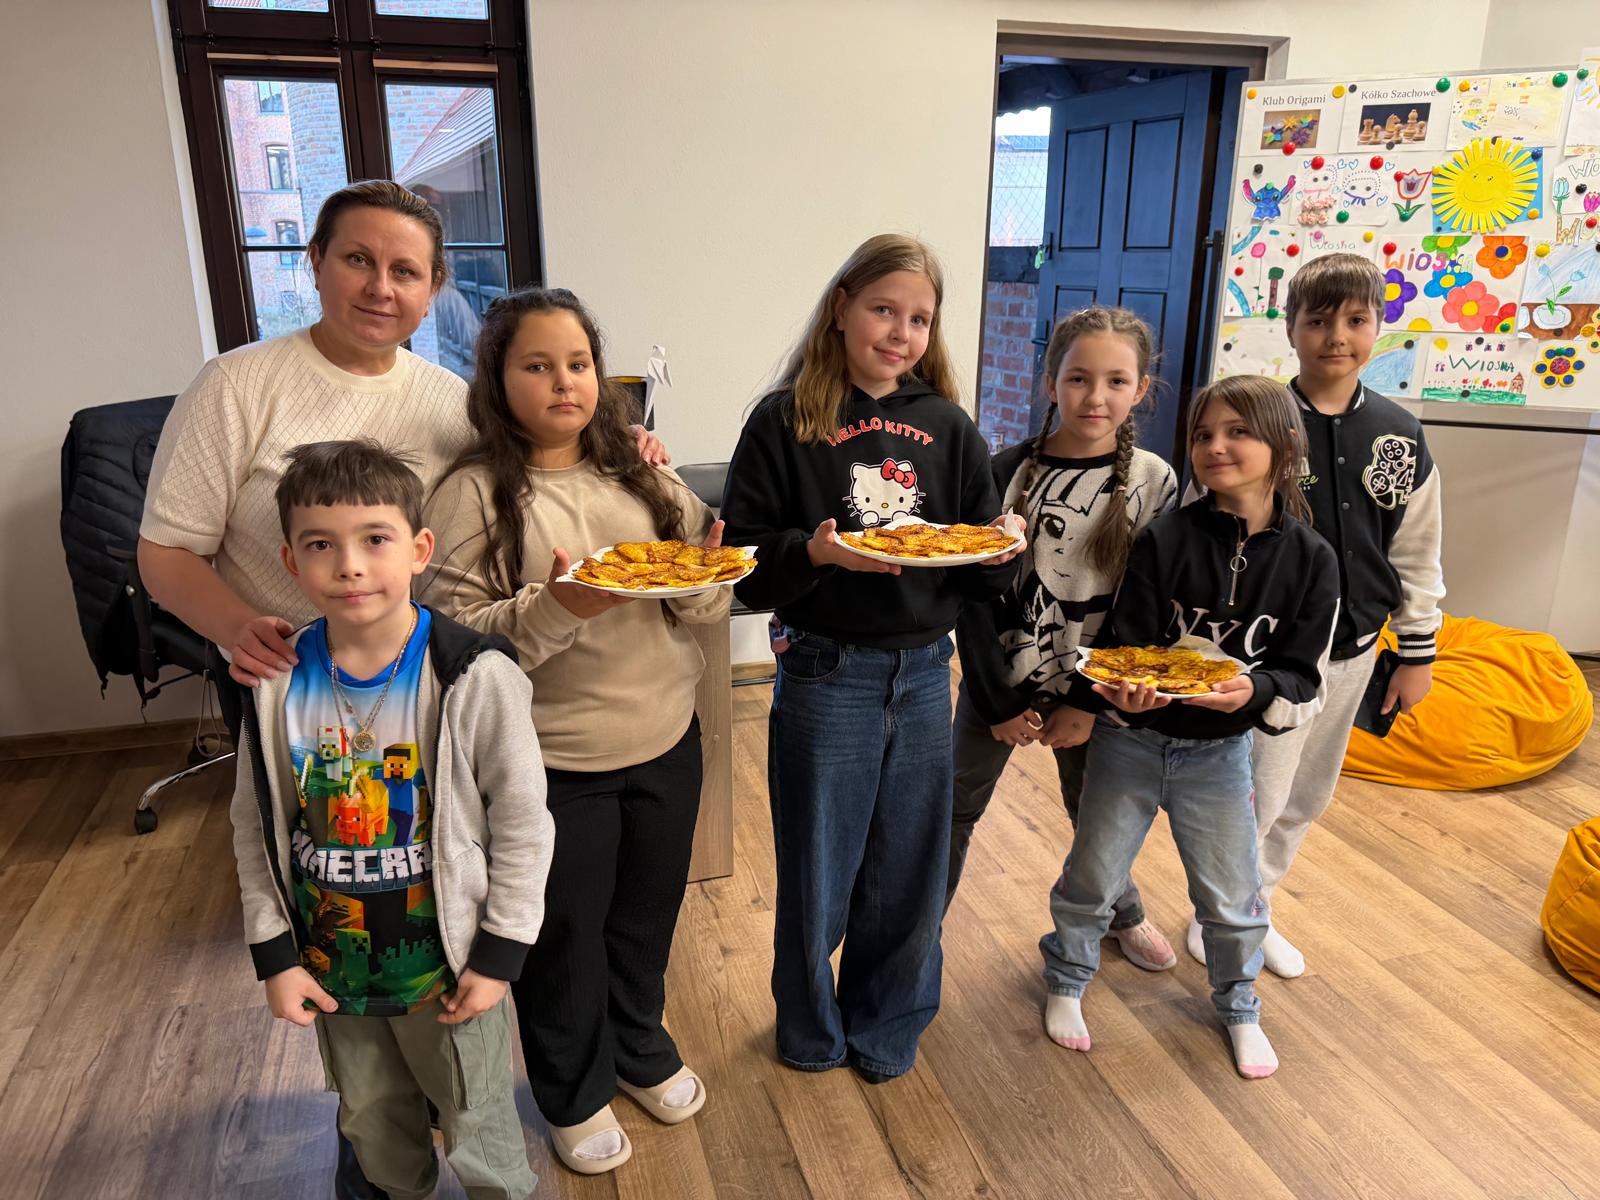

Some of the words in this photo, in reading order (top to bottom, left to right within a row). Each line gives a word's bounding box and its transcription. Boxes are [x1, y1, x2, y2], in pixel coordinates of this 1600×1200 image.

[1262, 96, 1285, 106] Klub
[1287, 94, 1327, 107] Origami
[1361, 90, 1389, 100] Kółko
[1391, 88, 1438, 99] Szachowe
[827, 417, 883, 447] HELLO
[884, 420, 934, 446] KITTY
[1164, 599, 1279, 658] NYC
